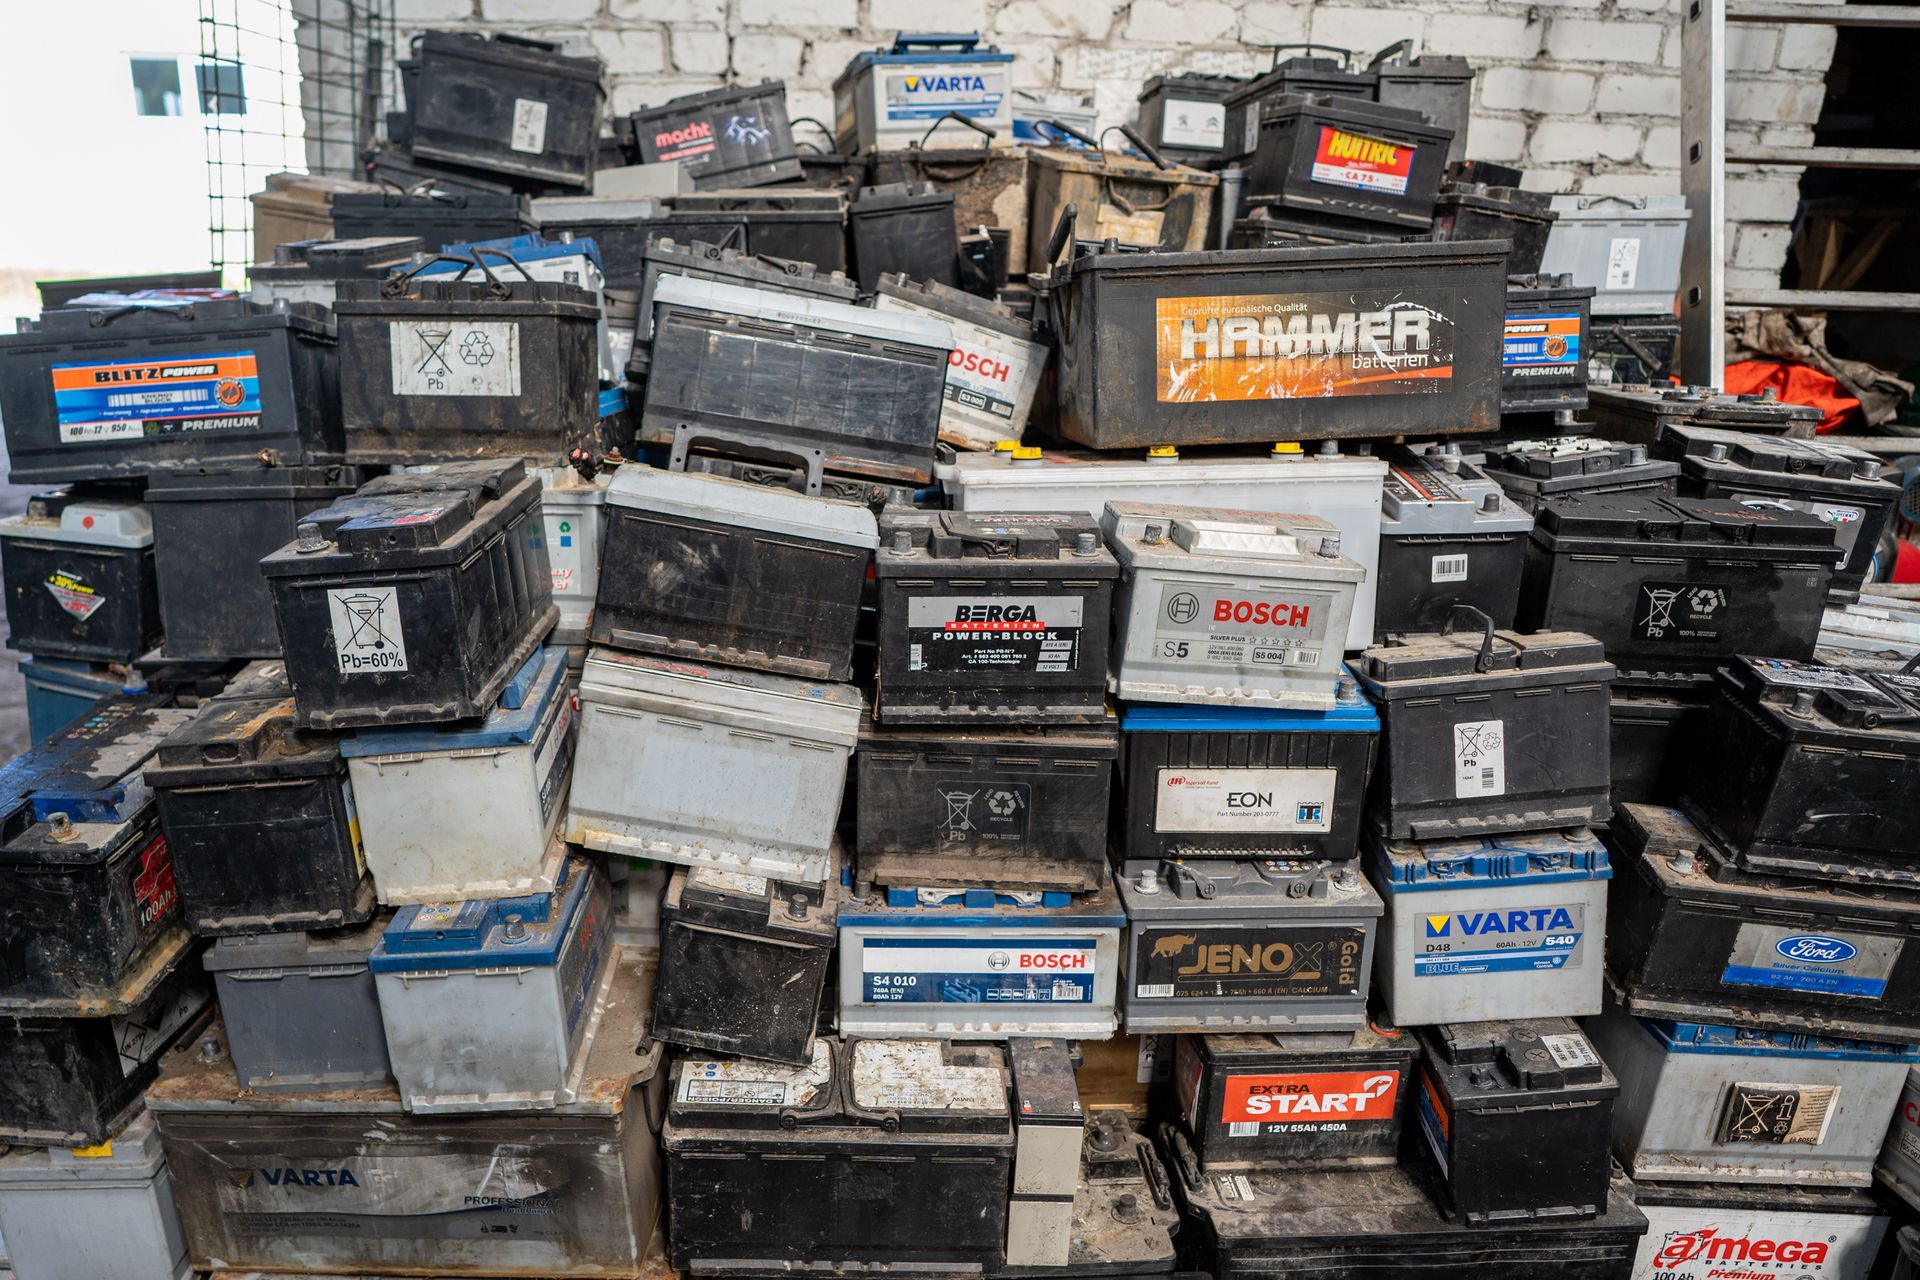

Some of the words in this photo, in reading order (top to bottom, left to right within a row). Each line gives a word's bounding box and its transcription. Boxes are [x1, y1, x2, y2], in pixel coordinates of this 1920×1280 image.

[922, 76, 985, 92] VARTA
[655, 122, 712, 148] macht
[1345, 172, 1358, 180] CA
[1361, 173, 1374, 182] 75
[1181, 305, 1219, 317] Geprüfte
[1221, 303, 1272, 315] europäische
[1274, 302, 1308, 313] Qualität
[1181, 310, 1430, 360] HAMMER
[1504, 325, 1547, 333] POWER
[949, 348, 1010, 382] OSCH
[1352, 354, 1428, 369] batterien
[94, 367, 160, 384] BLITZ
[162, 364, 217, 379] POWER
[1512, 366, 1575, 377] PREMIUM
[428, 378, 444, 390] Pb
[70, 427, 84, 436] 100
[111, 424, 127, 433] 950
[182, 417, 260, 431] PREMIUM
[955, 605, 1037, 622] BERGA
[1213, 599, 1310, 628] BOSCH
[932, 632, 1058, 640] POWER-BLOCK
[1647, 627, 1664, 637] Pb
[1163, 640, 1190, 658] S5
[341, 652, 404, 669] Pb=60%
[1463, 759, 1477, 767] Pb
[1226, 792, 1273, 808] EON
[949, 831, 966, 841] Pb
[1457, 908, 1575, 936] VARTA
[1426, 943, 1451, 953] D48
[1496, 941, 1516, 949] 60Ah
[1545, 935, 1575, 946] 540
[1790, 938, 1839, 960] Ford
[1019, 954, 1086, 969] BOSCH
[1178, 942, 1324, 975] JENOX
[1338, 941, 1358, 985] Gold
[1426, 962, 1460, 974] BLUE
[1773, 962, 1801, 970] Silver
[1803, 965, 1845, 974] Calcium
[873, 976, 890, 986] S4
[893, 976, 917, 986] 010
[1291, 985, 1328, 994] CALCIUM
[1250, 1084, 1310, 1095] EXTRA
[1245, 1092, 1376, 1115] START
[1267, 1125, 1288, 1133] 12V
[1290, 1124, 1318, 1133] 55Ah
[1320, 1123, 1347, 1132] 450A
[258, 1167, 361, 1187] VARTA
[1705, 1260, 1822, 1271] BATTERIES
[1707, 1270, 1775, 1280] Premium
